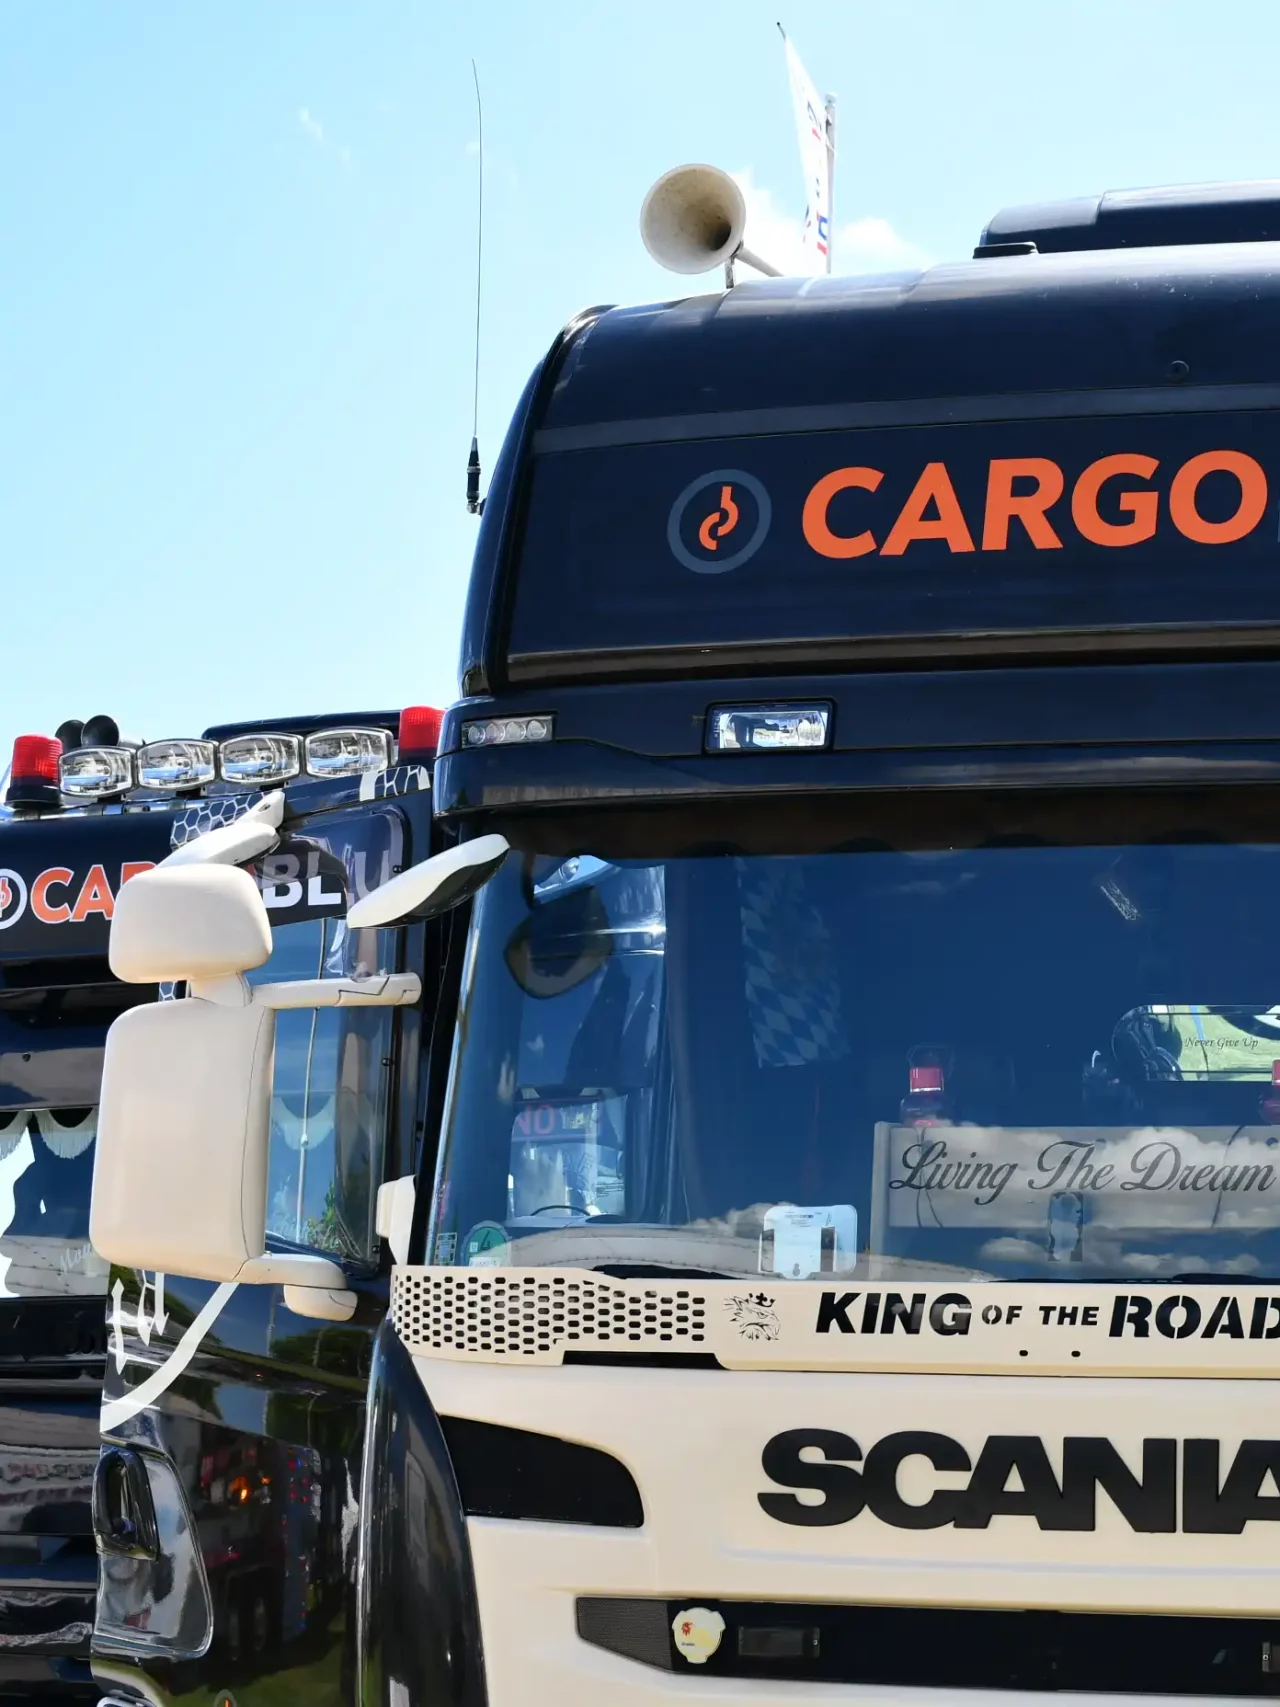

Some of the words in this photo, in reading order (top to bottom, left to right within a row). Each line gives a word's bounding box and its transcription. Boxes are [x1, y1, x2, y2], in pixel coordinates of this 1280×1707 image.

[1185, 1037, 1215, 1047] Never
[1217, 1037, 1239, 1049] Give
[1242, 1036, 1258, 1049] Up
[888, 1140, 1019, 1206] Living
[1028, 1140, 1117, 1191] The
[1120, 1141, 1278, 1192] Dream
[815, 1291, 972, 1335] KING
[981, 1304, 1023, 1326] OF
[1039, 1305, 1099, 1327] THE
